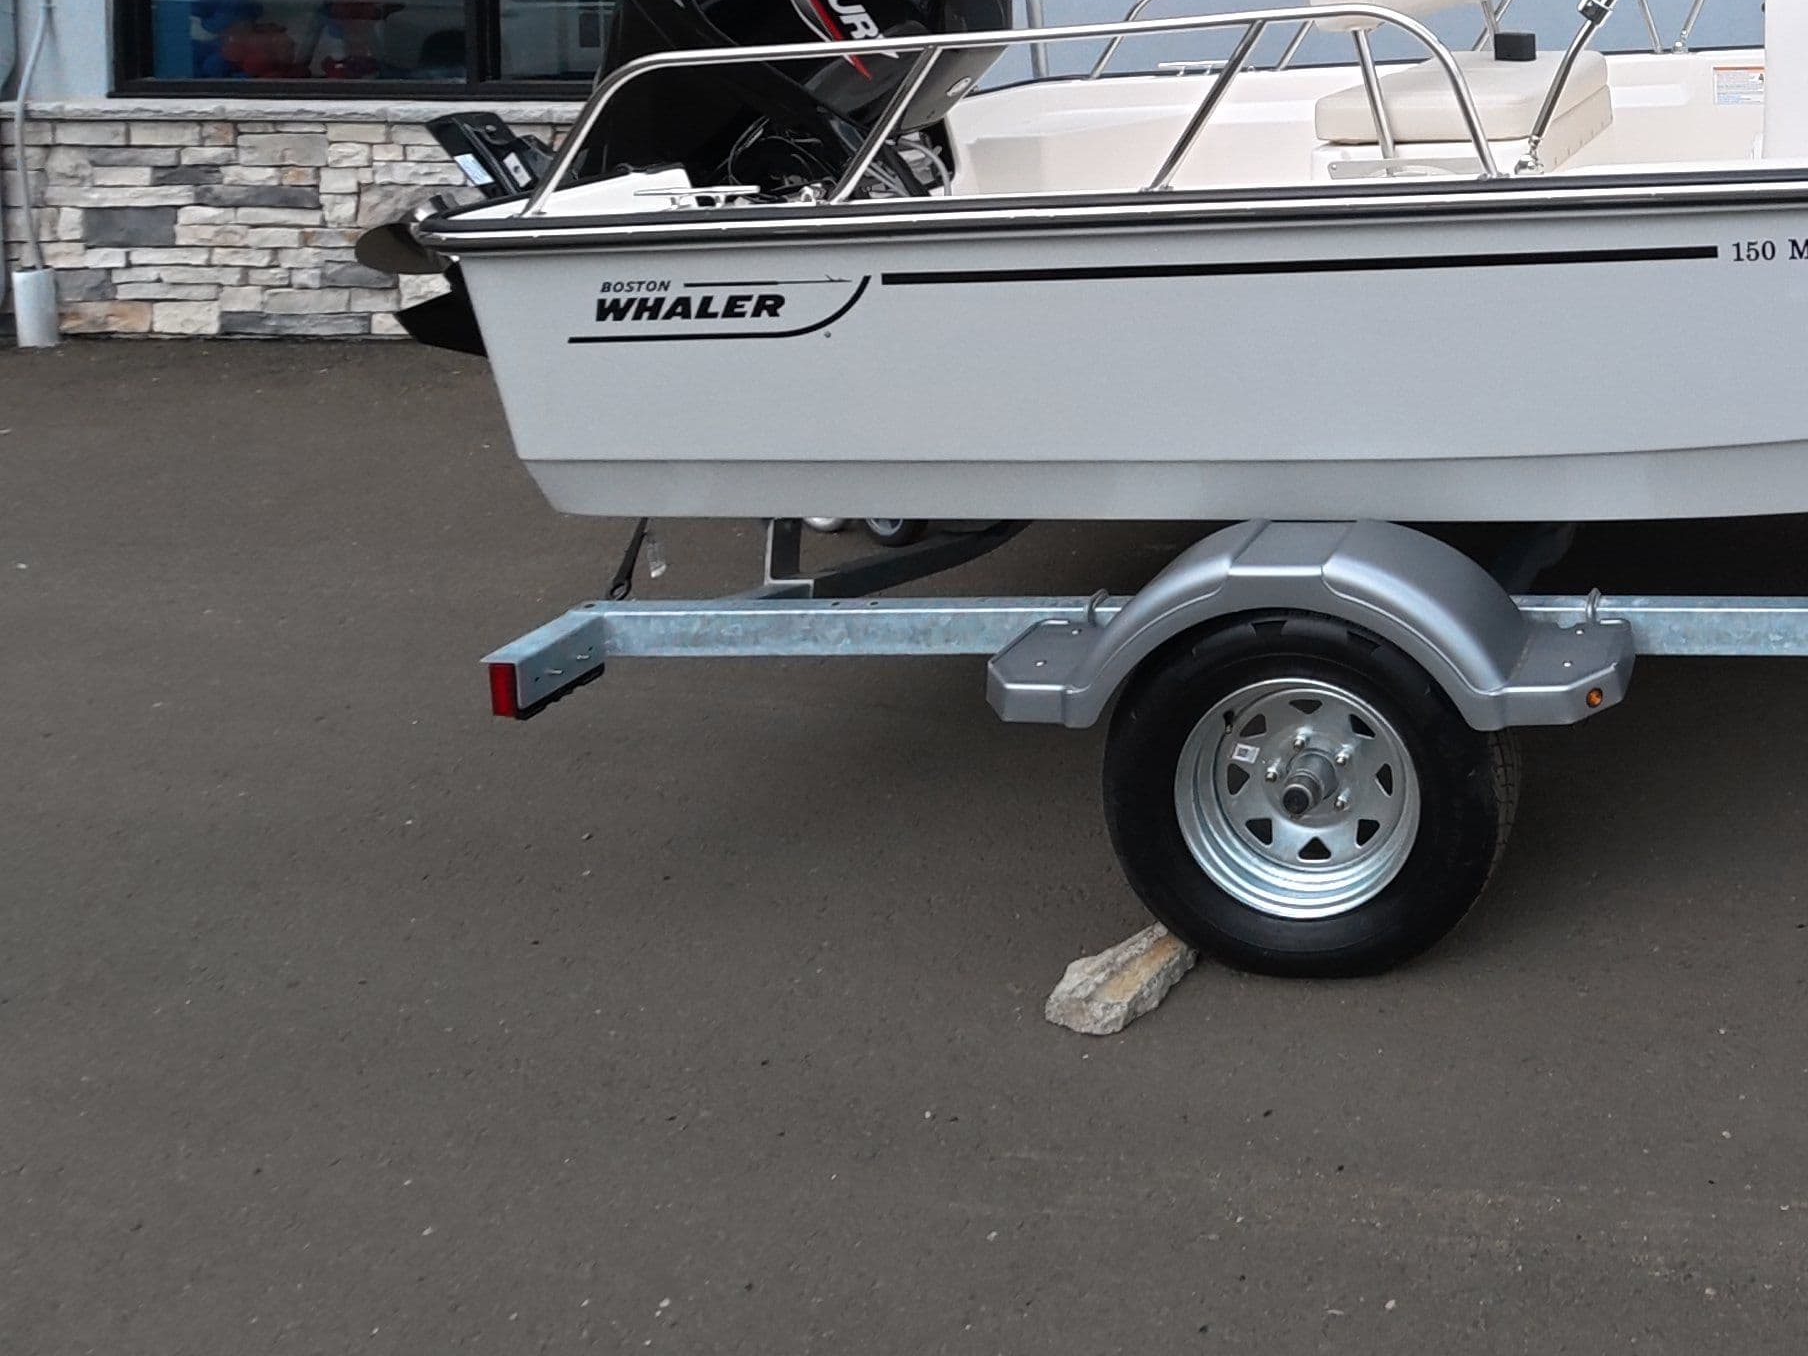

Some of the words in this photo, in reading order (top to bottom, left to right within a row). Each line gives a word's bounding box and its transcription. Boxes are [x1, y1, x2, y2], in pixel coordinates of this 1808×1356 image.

[1732, 241, 1776, 262] 150
[601, 280, 671, 293] BOSTON
[595, 294, 786, 321] WHALER
